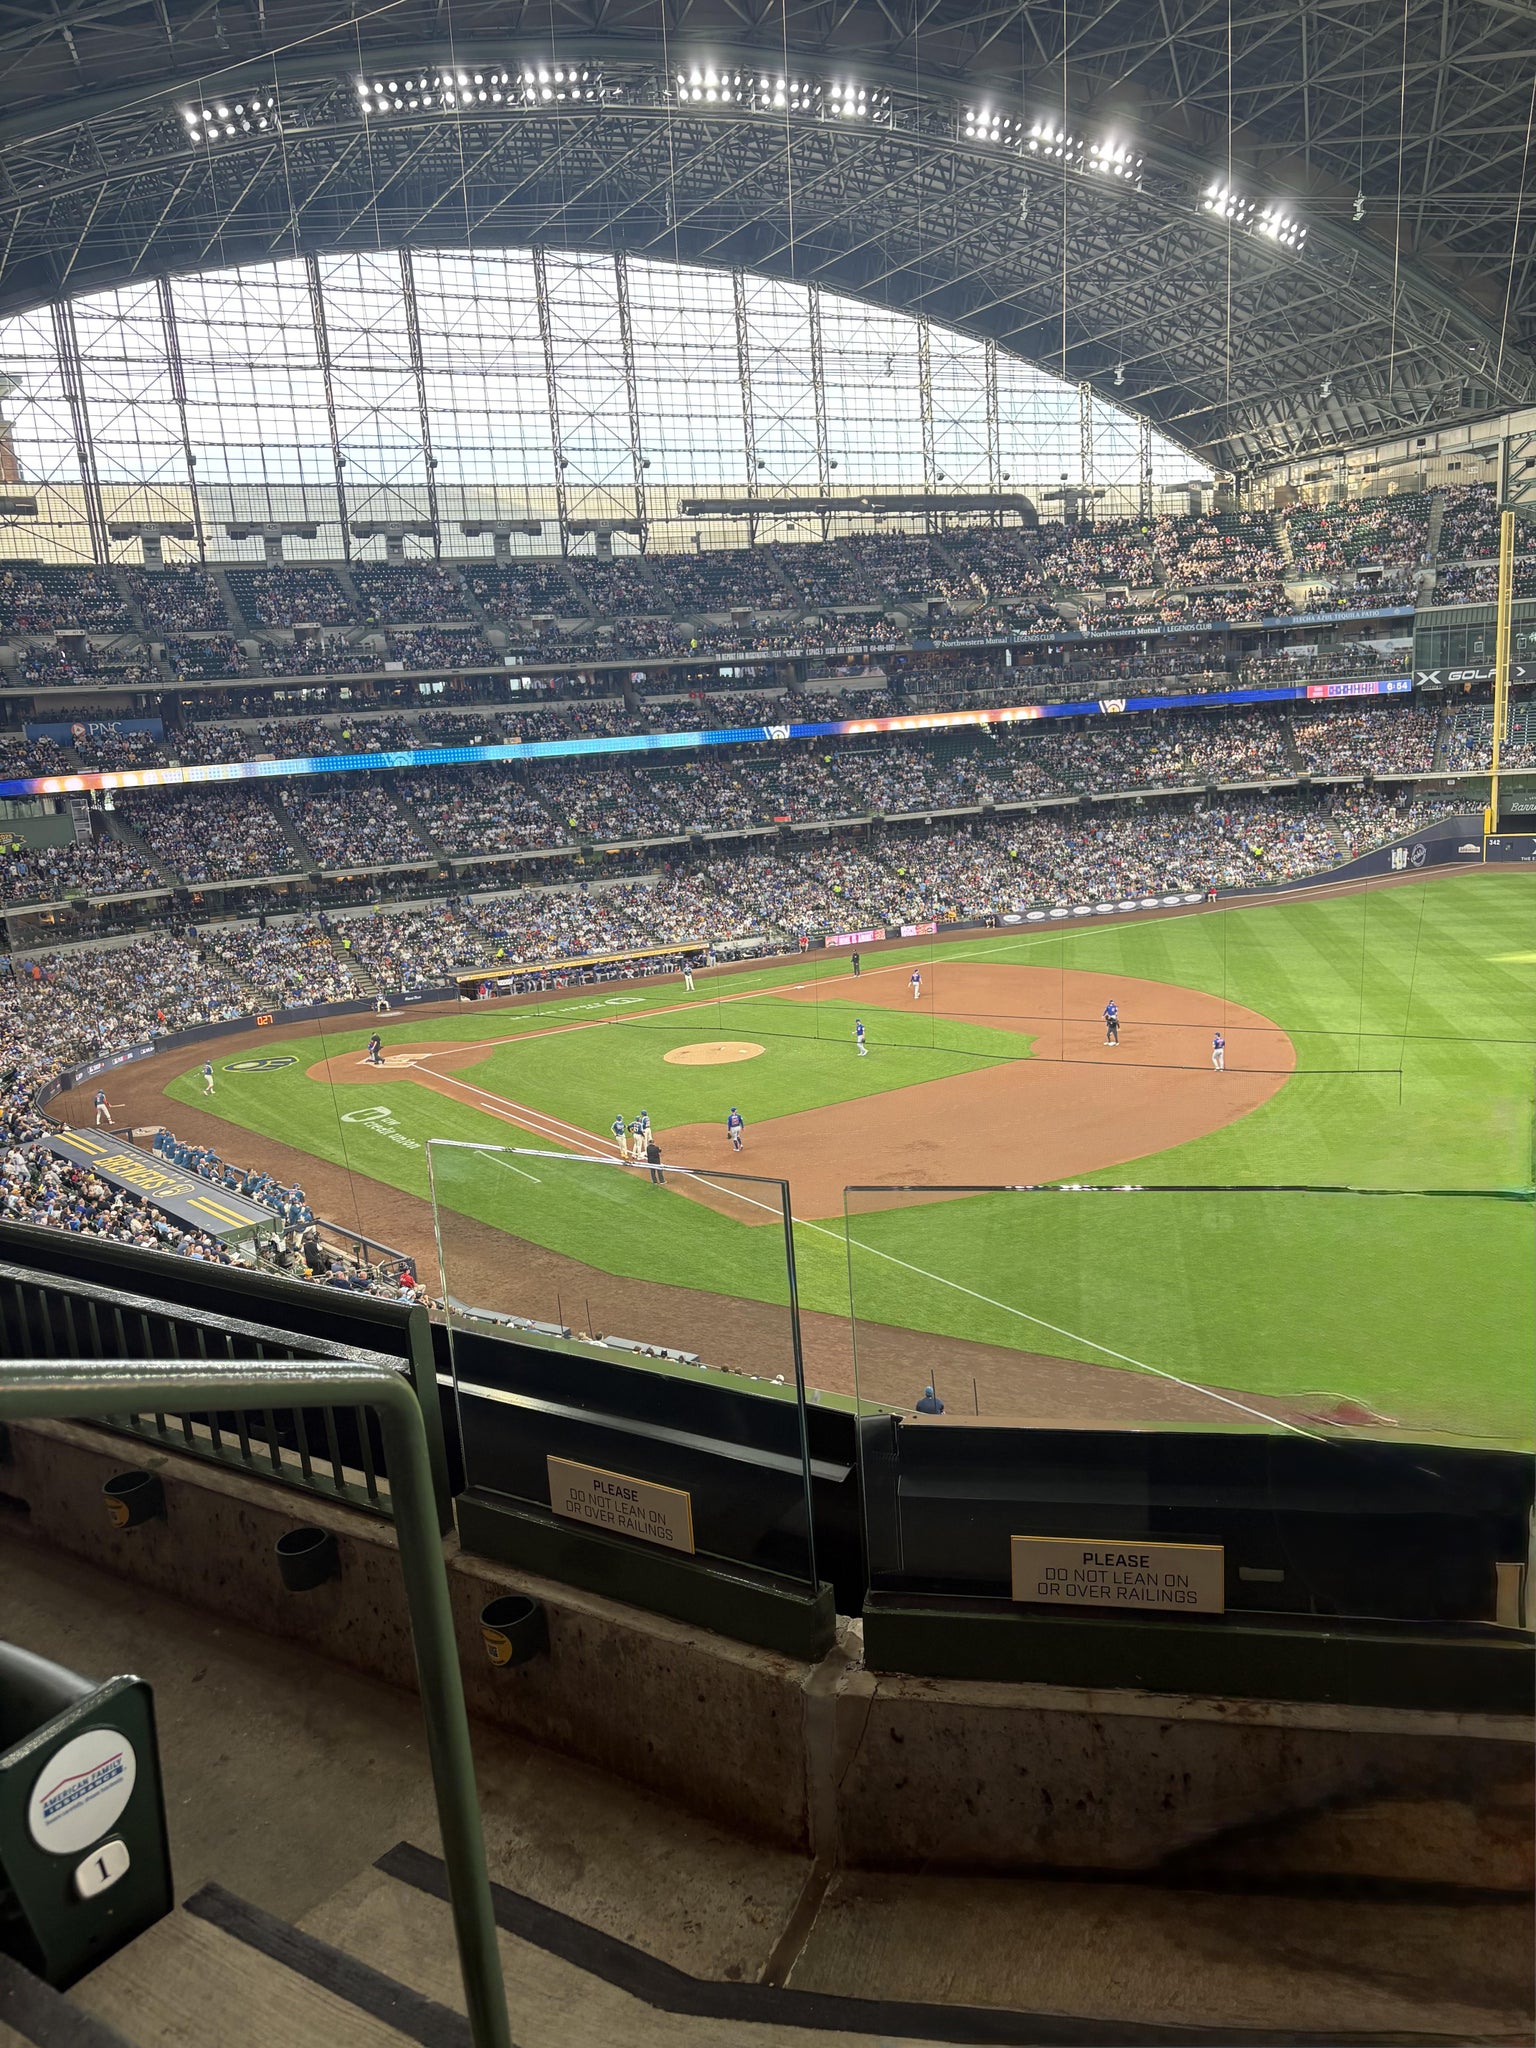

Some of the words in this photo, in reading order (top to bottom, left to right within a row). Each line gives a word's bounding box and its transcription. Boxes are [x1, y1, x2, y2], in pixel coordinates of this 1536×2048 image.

[1334, 612, 1360, 620] TEQUILA
[1361, 610, 1380, 618] PATIO
[941, 639, 985, 648] Northwestern
[985, 637, 1008, 645] Mutual
[1013, 634, 1040, 643] LEGENDS
[1040, 633, 1056, 641] CLUB
[1090, 629, 1136, 638] Northwestern
[1136, 626, 1161, 635] Mutual
[1167, 624, 1195, 633] LEGENDS
[1195, 623, 1213, 631] CLUB
[1386, 682, 1408, 691] 6:54
[88, 721, 122, 736] PNC
[364, 1121, 396, 1136] credit
[388, 1133, 421, 1149] union
[92, 1154, 177, 1190] BREWERS
[593, 1479, 639, 1503] PLEASE
[569, 1488, 586, 1503] DO
[588, 1493, 612, 1510] NOT
[614, 1500, 646, 1520] LEAN
[649, 1510, 666, 1526] ON
[566, 1500, 582, 1515] OR
[584, 1505, 616, 1524] OVER
[618, 1515, 674, 1541] RAILINGS
[1083, 1552, 1150, 1568] PLEASE
[1045, 1567, 1068, 1581] DO
[1073, 1569, 1109, 1583] NOT
[1113, 1571, 1159, 1587] LEAN
[1164, 1574, 1189, 1588] ON
[1037, 1582, 1060, 1596] OR
[1066, 1584, 1111, 1599] OVER
[1116, 1586, 1198, 1604] RAILINGS
[43, 1776, 90, 1810] AMERICAN
[90, 1757, 122, 1783] FAMILY
[48, 1769, 119, 1815] INSURANCE
[95, 1855, 111, 1882] 1
